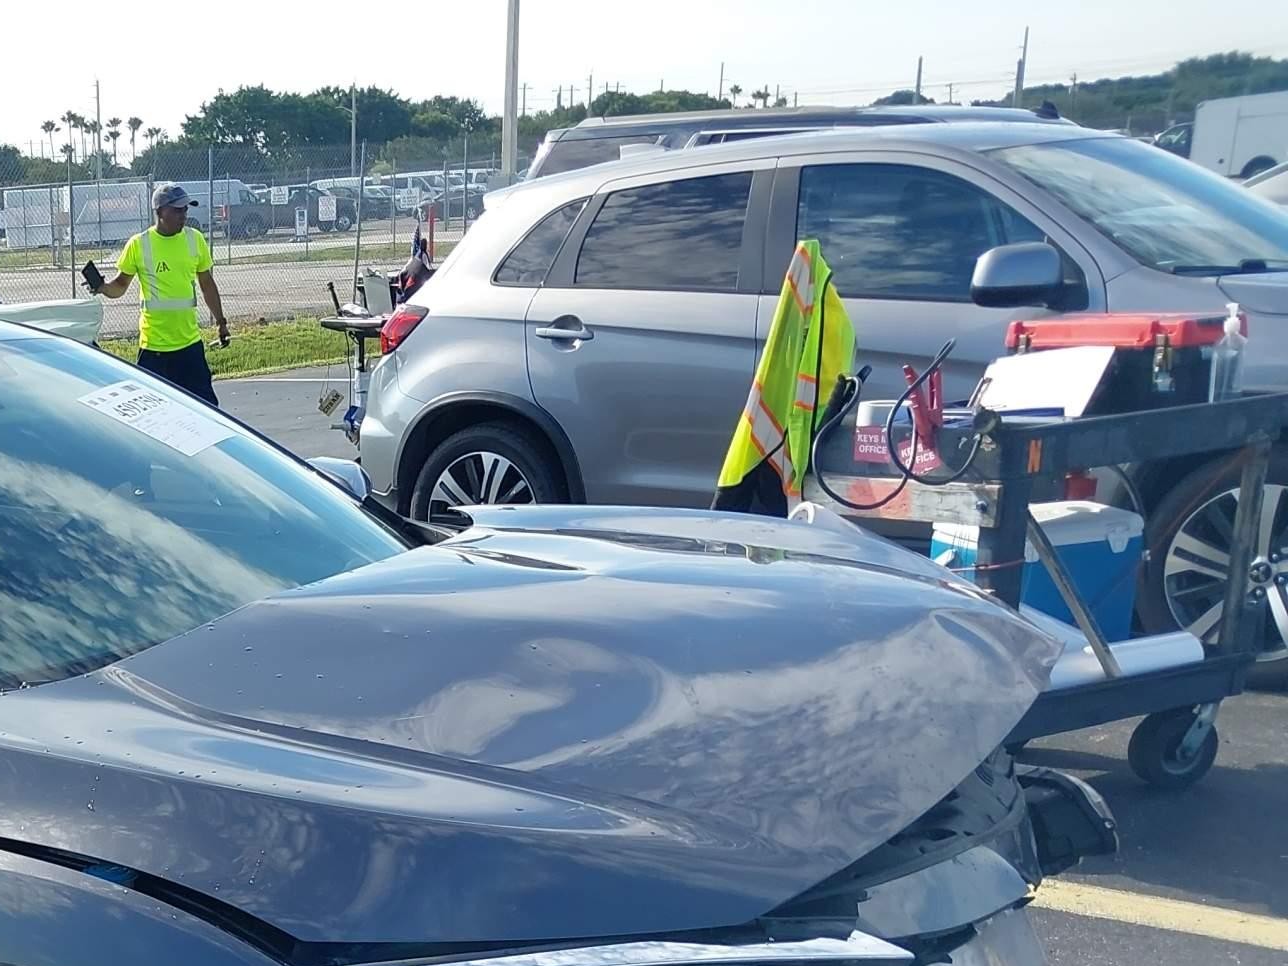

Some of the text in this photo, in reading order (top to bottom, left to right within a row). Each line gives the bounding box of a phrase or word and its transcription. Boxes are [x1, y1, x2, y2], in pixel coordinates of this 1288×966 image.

[112, 392, 169, 418] 45927594
[857, 434, 879, 443] KEYS
[858, 444, 887, 454] OFFICE
